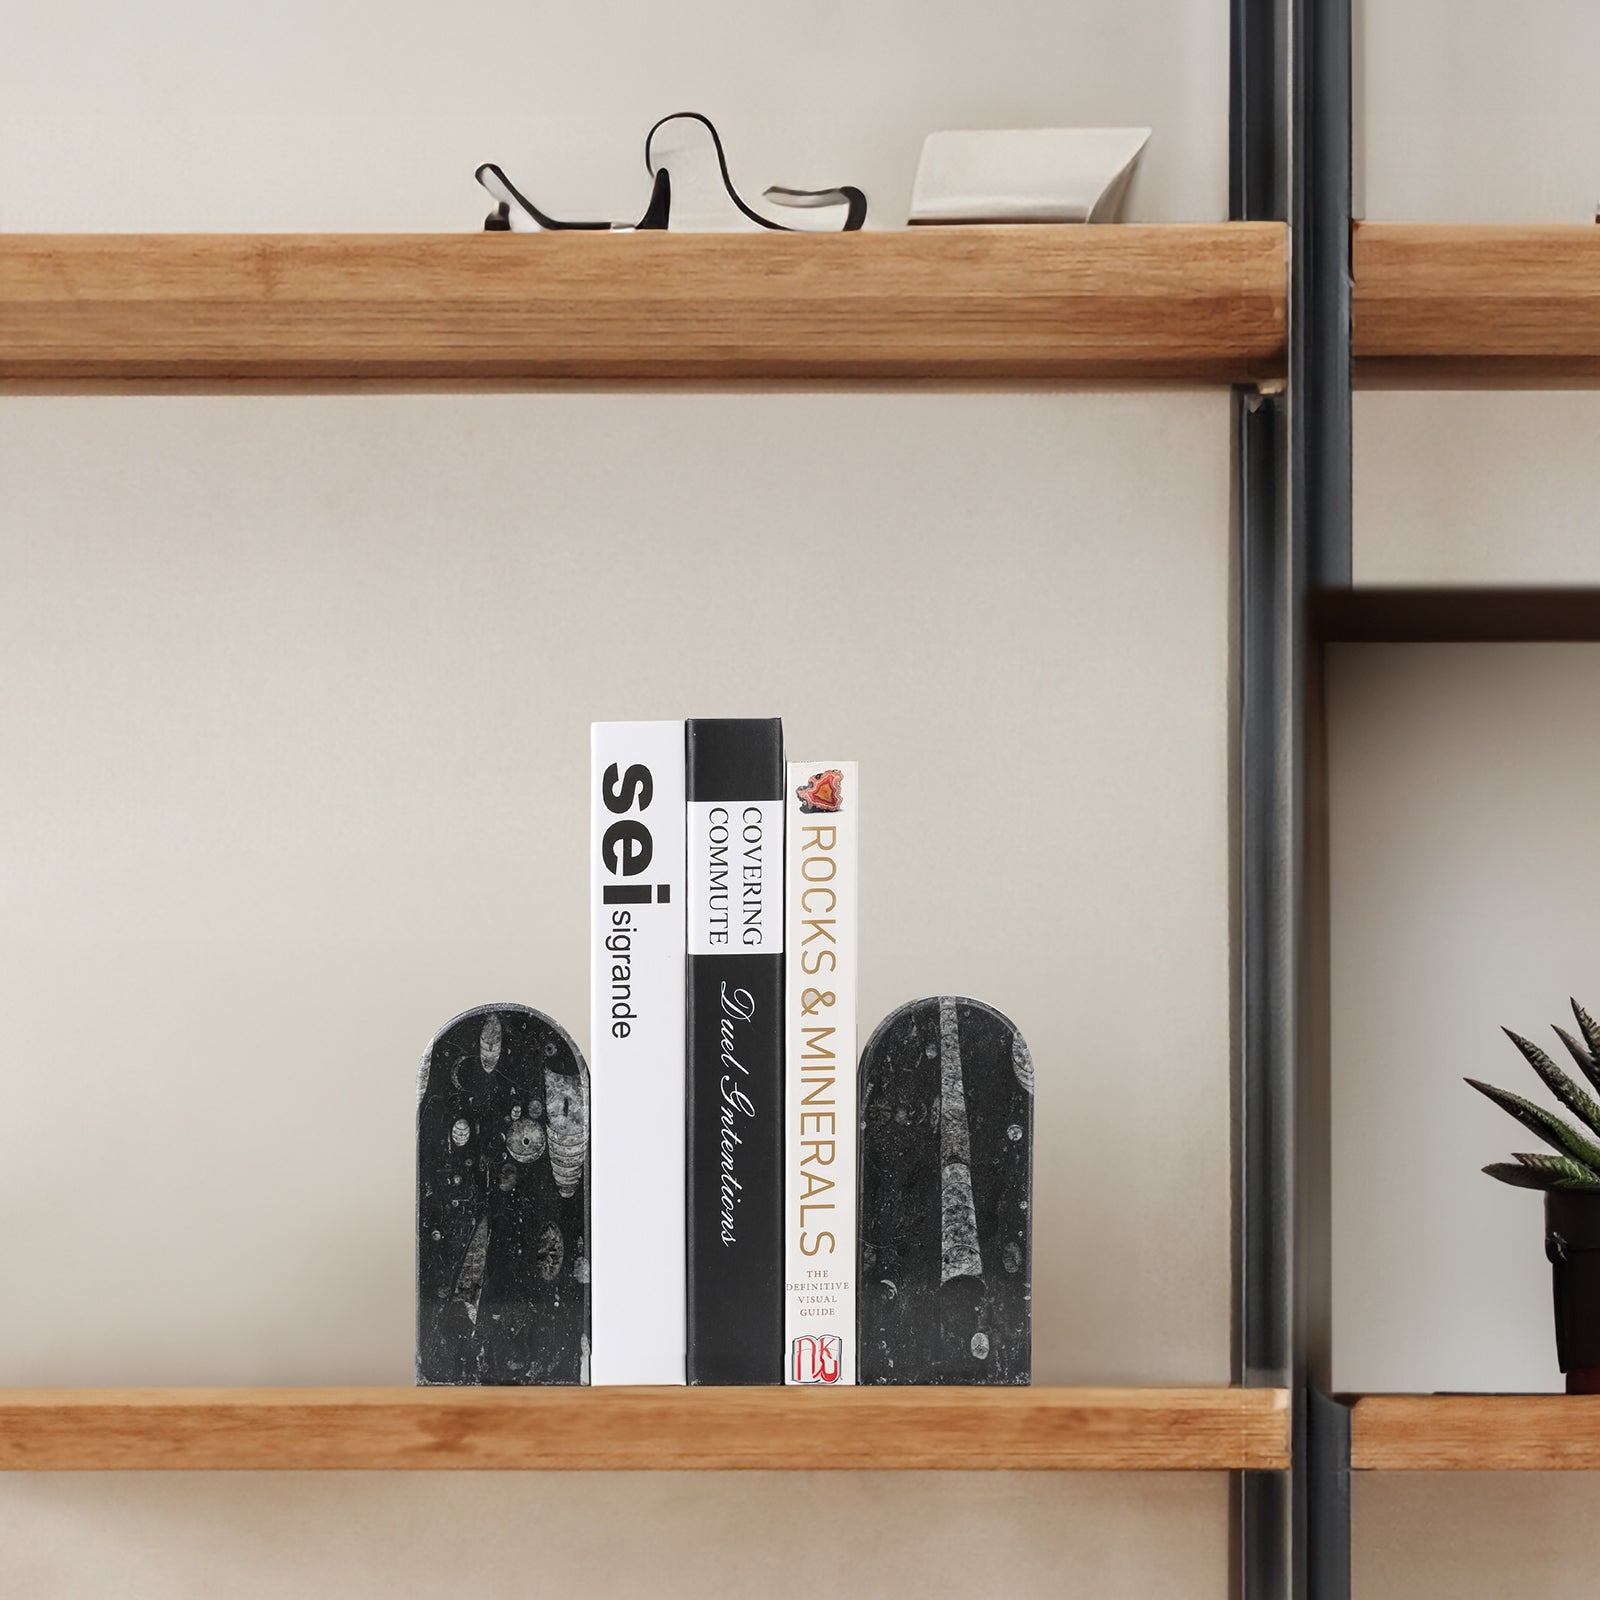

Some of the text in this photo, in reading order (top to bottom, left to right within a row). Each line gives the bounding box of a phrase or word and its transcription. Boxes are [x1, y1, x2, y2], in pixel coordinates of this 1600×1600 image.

[602, 762, 670, 1039] sei sigrande
[709, 807, 730, 946] COMMUTE
[742, 807, 763, 947] COVERING
[720, 980, 756, 1076] Duel
[799, 826, 837, 1257] ROCKS & MINERALS
[786, 1282, 850, 1291] DEFINITIVE
[798, 1295, 838, 1304] VISUAL
[799, 1308, 835, 1317] GUIDE
[806, 1270, 829, 1278] THE
